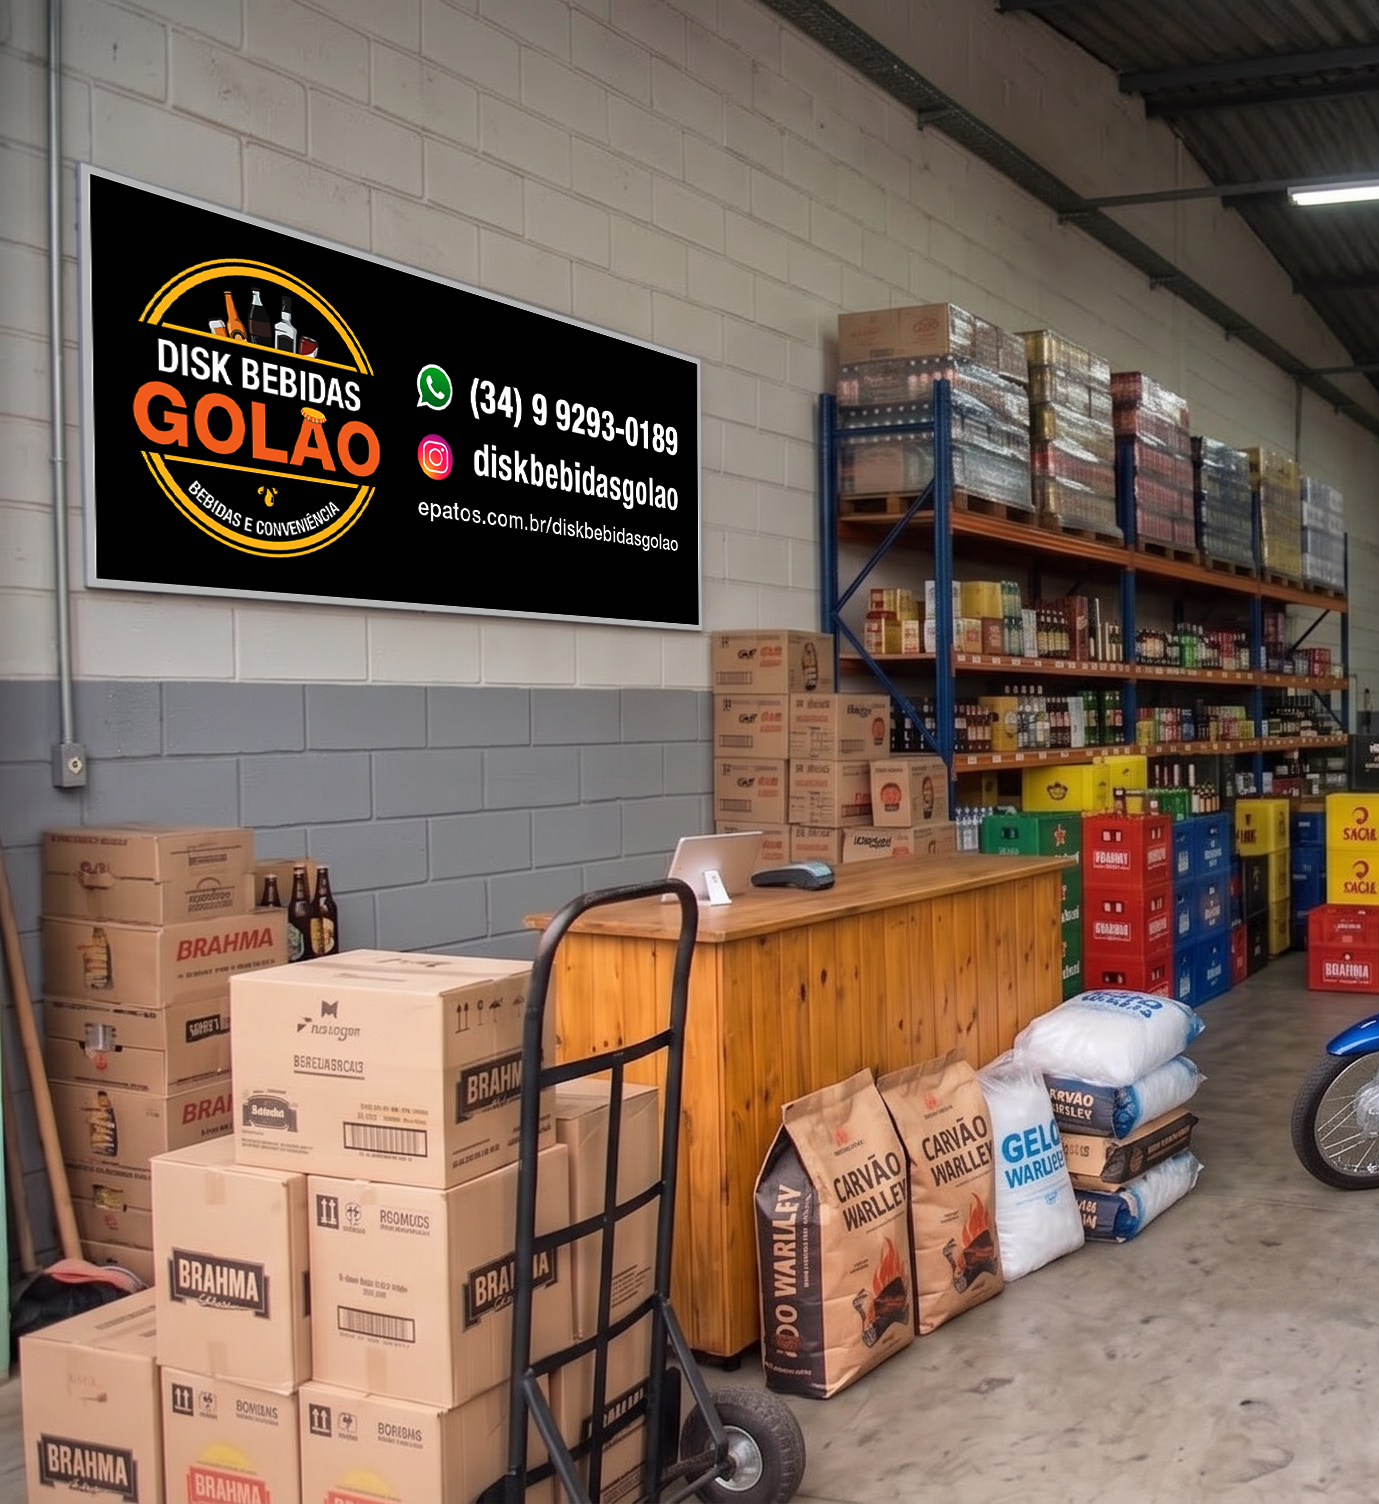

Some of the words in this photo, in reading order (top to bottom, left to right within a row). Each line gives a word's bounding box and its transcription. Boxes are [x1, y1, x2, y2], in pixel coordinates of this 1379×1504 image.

[157, 338, 233, 386] DISK
[241, 356, 362, 412] BEBIDAS
[470, 377, 523, 428] (34)
[531, 393, 548, 426] 9
[555, 398, 679, 456] 9293-0189
[473, 443, 679, 511] diskbebidasgolao
[187, 480, 243, 528] BEBIDAS
[243, 516, 254, 532] E
[255, 500, 341, 537] CONVENIÊNCIA
[417, 500, 679, 552] epatos.com.br/diskbebidasgolao
[176, 927, 274, 962] BRAHMA
[467, 1060, 523, 1105] BRAHM
[922, 1115, 988, 1162] CARVÃO
[833, 1152, 901, 1204] CARVÃO
[178, 1258, 260, 1303] BRAHMA
[46, 1442, 129, 1488] BRAHMA
[194, 1472, 262, 1504] BRAHMA
